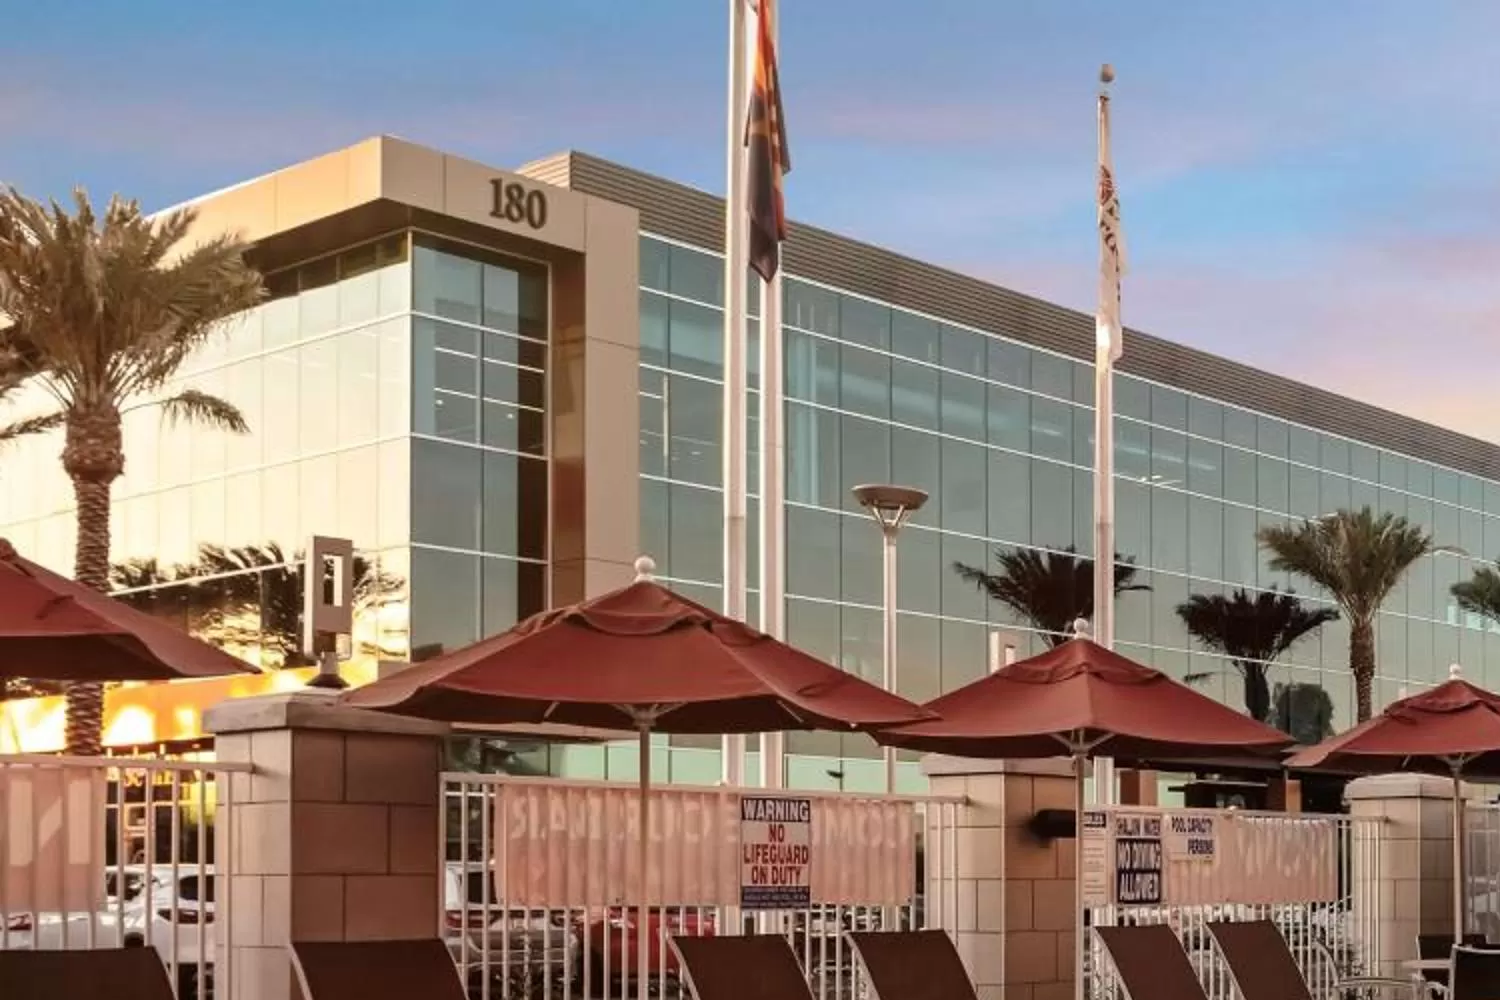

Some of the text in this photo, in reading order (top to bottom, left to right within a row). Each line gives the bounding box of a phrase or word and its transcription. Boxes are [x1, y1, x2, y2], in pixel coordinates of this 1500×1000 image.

[489, 178, 547, 229] 180
[743, 799, 809, 821] WARNING
[768, 824, 785, 842] NO
[743, 844, 809, 864] LIFEGUARD
[751, 866, 801, 885] ON DUTY
